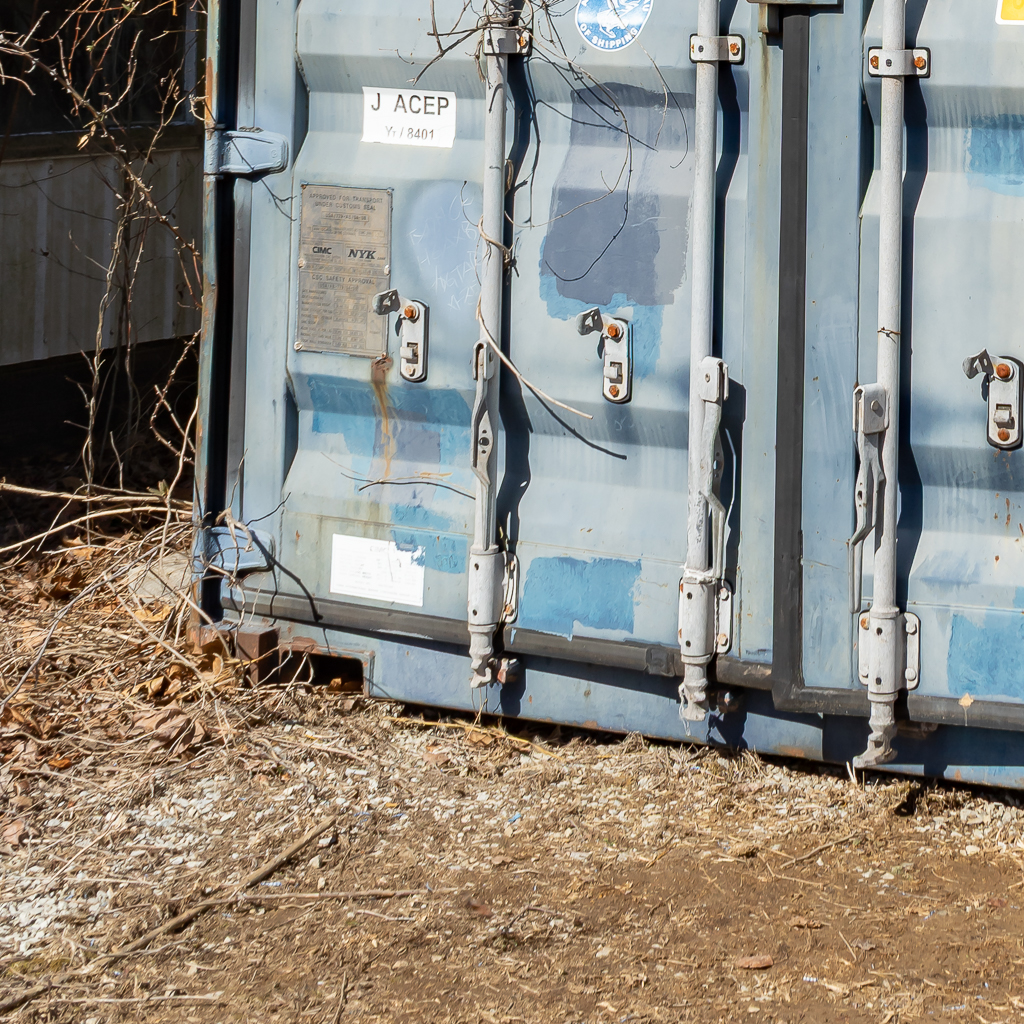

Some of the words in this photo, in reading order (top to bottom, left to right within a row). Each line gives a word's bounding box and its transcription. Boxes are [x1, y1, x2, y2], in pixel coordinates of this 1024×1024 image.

[580, 23, 592, 36] OF
[591, 27, 638, 49] SHIPPING
[371, 92, 381, 111] J
[393, 94, 449, 115] ACEP
[312, 246, 333, 255] CIMC
[347, 249, 377, 260] NYK
